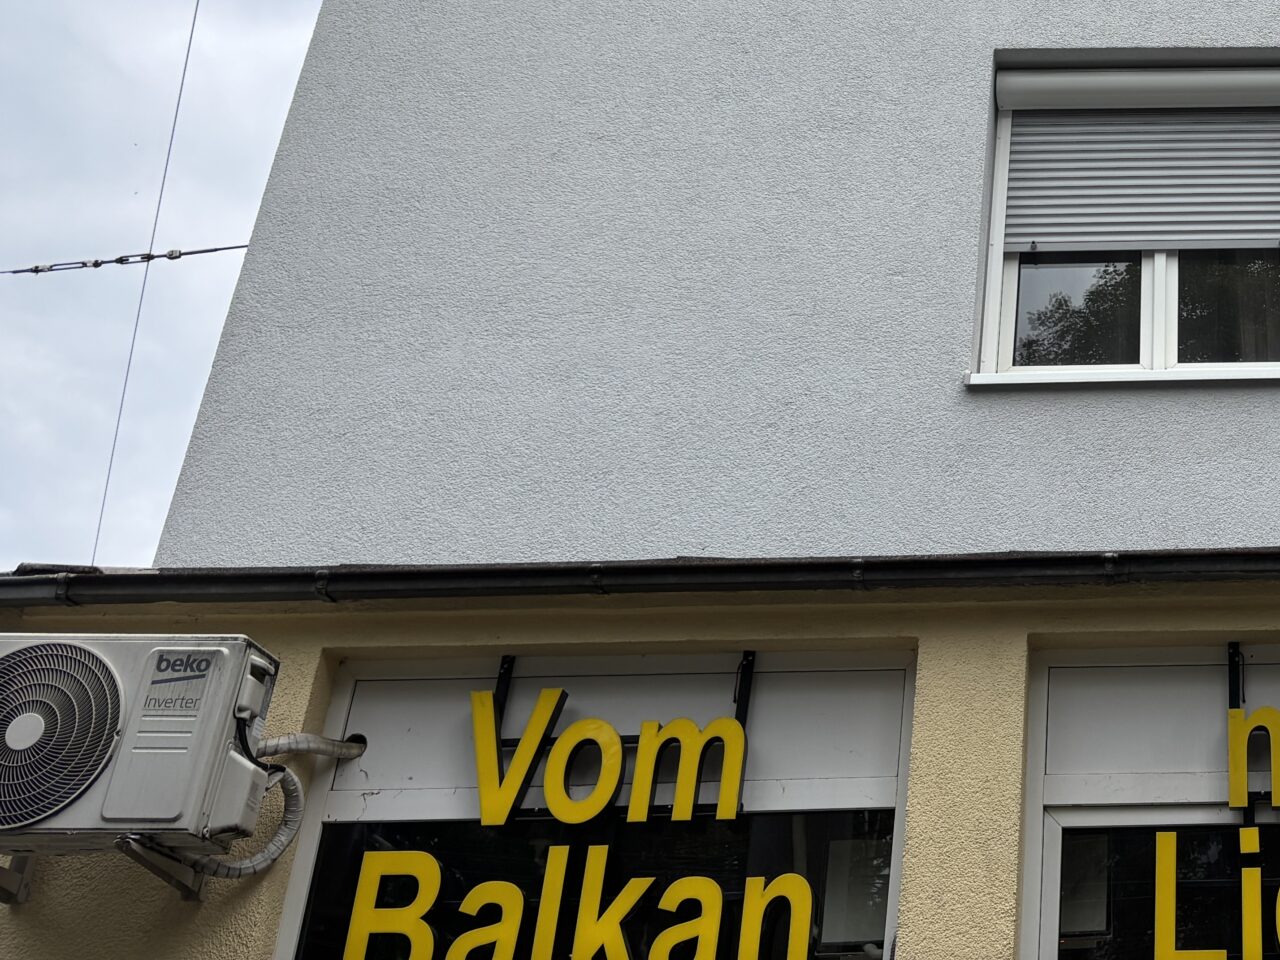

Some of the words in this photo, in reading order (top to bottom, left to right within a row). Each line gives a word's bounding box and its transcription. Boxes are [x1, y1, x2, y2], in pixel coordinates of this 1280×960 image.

[156, 654, 211, 673] beko
[143, 694, 201, 709] Inverter
[470, 688, 748, 826] Vom
[342, 844, 814, 960] Balkan
